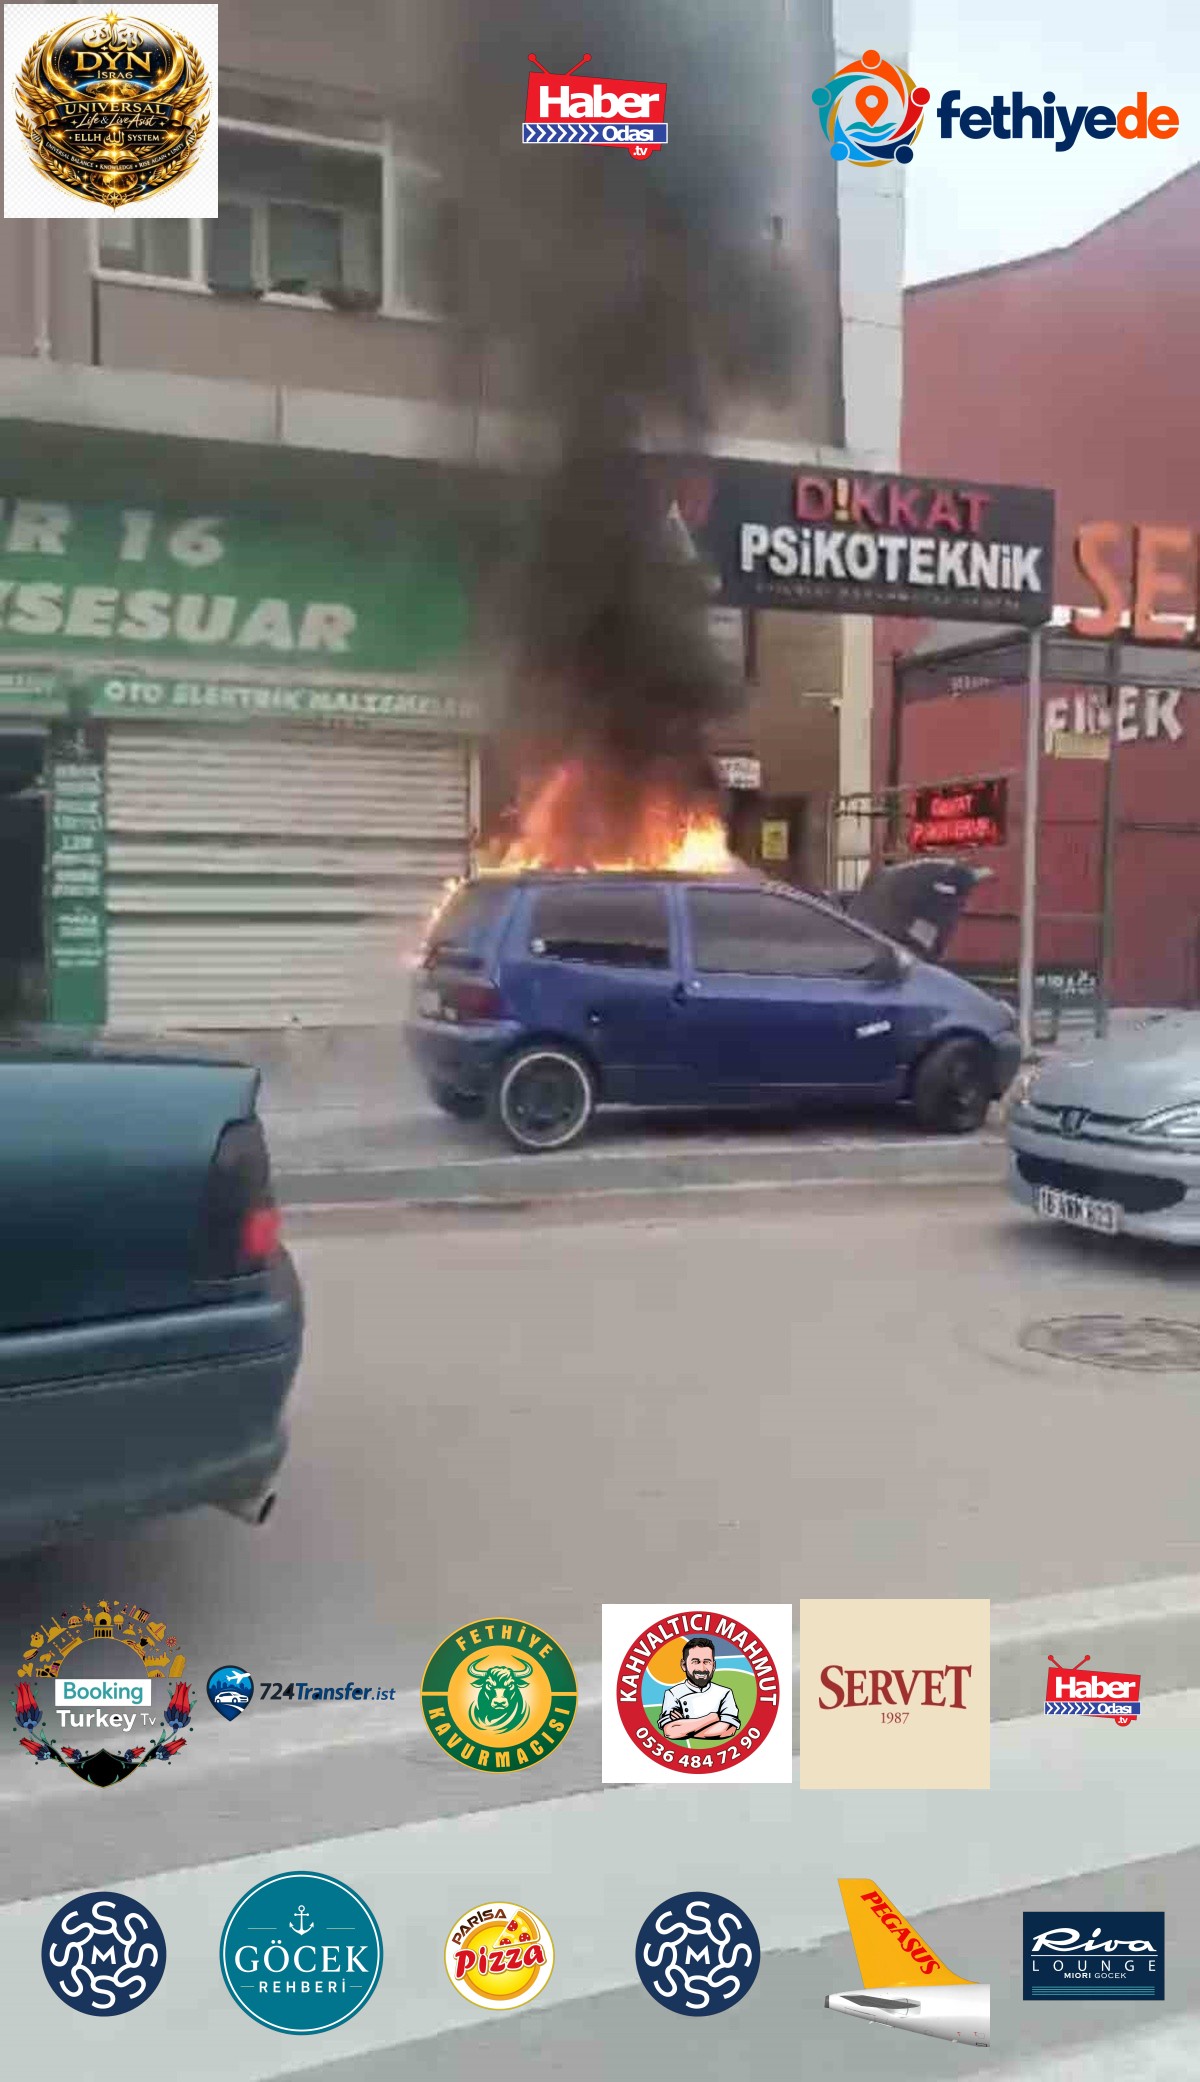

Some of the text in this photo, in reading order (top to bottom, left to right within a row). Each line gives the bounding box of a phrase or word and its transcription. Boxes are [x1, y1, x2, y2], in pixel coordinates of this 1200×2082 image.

[0, 499, 227, 567] R 16
[1072, 519, 1200, 642] SE
[102, 679, 163, 705] OTO
